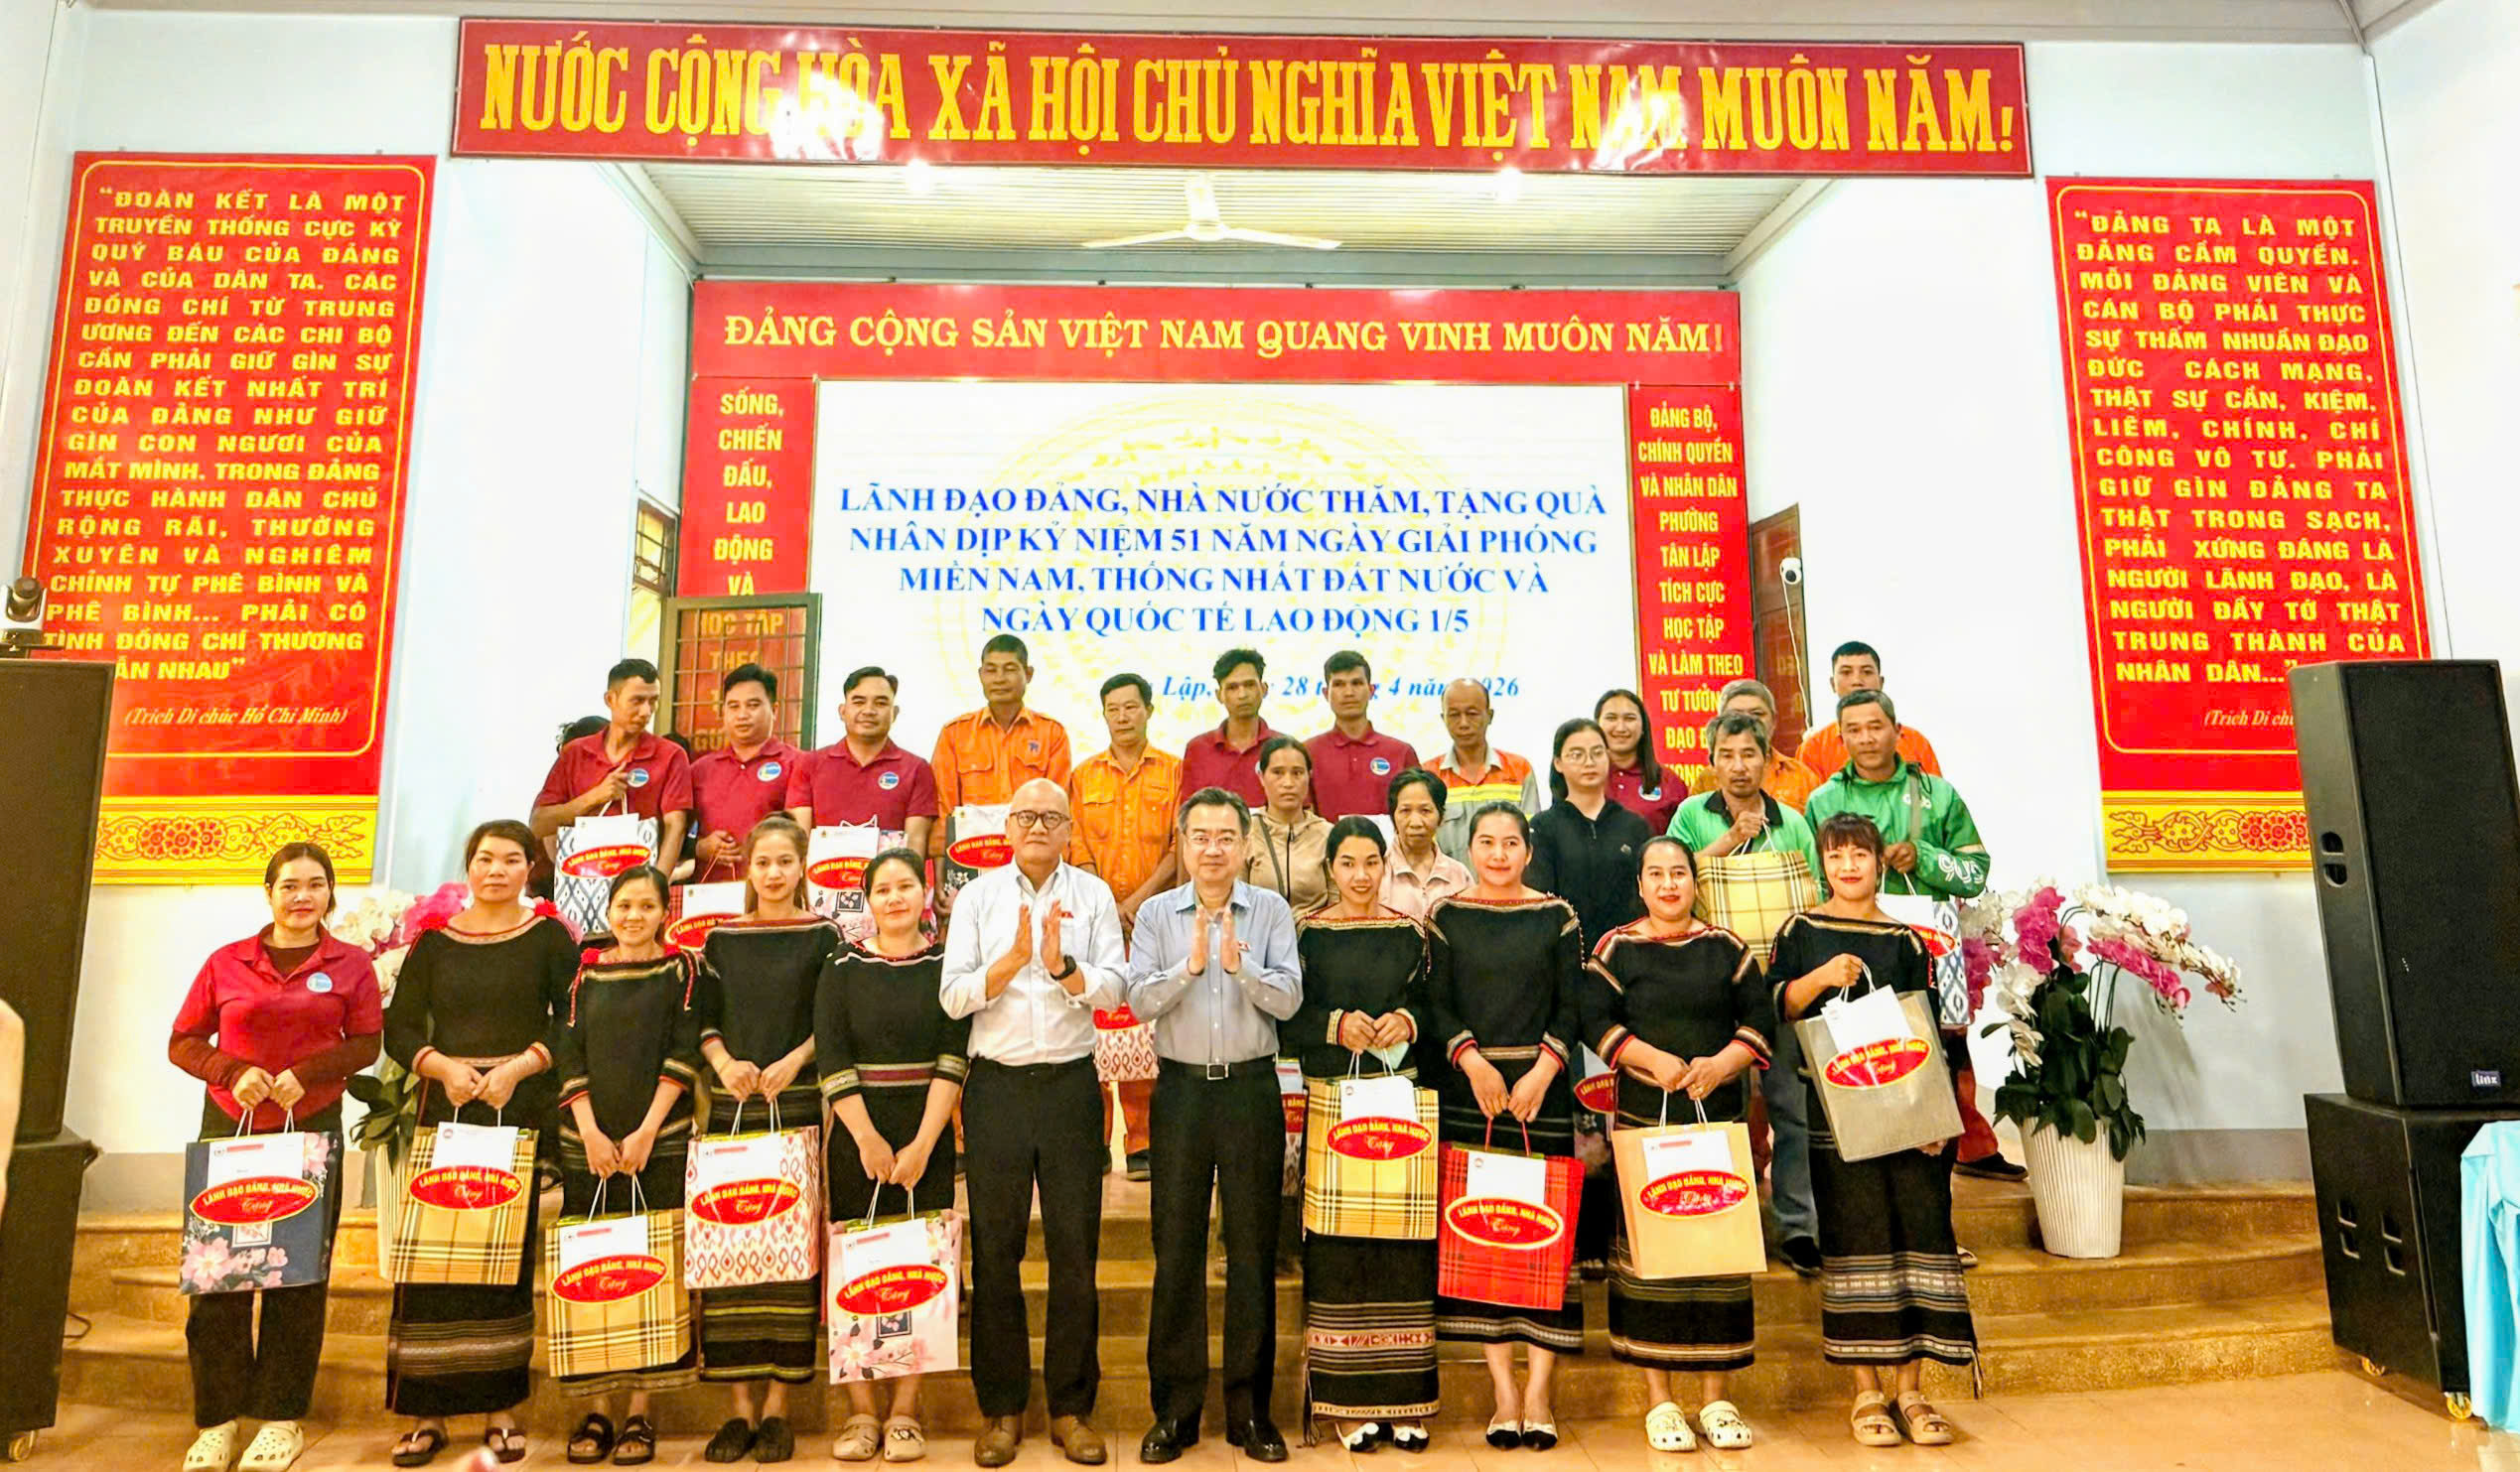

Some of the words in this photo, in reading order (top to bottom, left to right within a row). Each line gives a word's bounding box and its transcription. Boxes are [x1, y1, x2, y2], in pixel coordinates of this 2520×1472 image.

[480, 31, 630, 133] NƯỚC
[644, 33, 784, 148] CỘNG
[927, 41, 1018, 142] XÃ
[1029, 43, 1119, 156] HỘI
[1133, 46, 1238, 144] CHỦ
[1249, 48, 1420, 146] NGHĨA
[1421, 49, 1557, 162] VIỆT
[1568, 65, 1688, 151] NAM
[1698, 54, 1850, 151] MUÔN
[1864, 54, 2014, 152] NĂM!
[724, 306, 837, 346] ĐẢNG
[850, 308, 960, 356] CỘNG
[971, 308, 1049, 348] SẢN
[1057, 311, 1149, 359] VIỆT
[1160, 319, 1245, 349] NAM
[1257, 321, 1388, 358] QUANG
[1398, 322, 1491, 351] VINH
[1502, 315, 1614, 351] MUÔN
[720, 386, 784, 417] SỐNG,
[1650, 401, 1690, 428] ĐẢNG
[1693, 405, 1717, 433] BỘ,
[718, 423, 782, 452] CHIẾN
[1638, 438, 1682, 462] CHÍNH
[1686, 437, 1733, 465] QUYỀN
[723, 458, 772, 489] ĐẤU,
[1640, 472, 1660, 496] VÀ
[1663, 472, 1704, 496] NHÂN
[1708, 473, 1738, 496] DÂN
[726, 501, 766, 524] LAO
[840, 482, 935, 511] LÃNH
[944, 488, 1018, 518] ĐẠO
[1024, 481, 1129, 516] ĐẢNG,
[1136, 481, 1207, 512] NHÀ
[1215, 483, 1314, 514] NƯỚC
[1320, 484, 1430, 516] THĂM,
[1435, 487, 1527, 520] TẶNG
[1535, 484, 1607, 519] QUÀ
[714, 534, 773, 565] ĐỘNG
[850, 520, 946, 551] NHÂN
[955, 528, 1012, 558] DỊP
[1019, 520, 1066, 551] KỶ
[1075, 523, 1163, 558] NIỆM
[1171, 528, 1199, 552] 51
[1211, 522, 1288, 552] NĂM
[1296, 521, 1390, 553] NGÀY
[1397, 522, 1471, 553] GIẢI
[1479, 522, 1598, 554] PHÓNG
[1660, 543, 1689, 567] TÂN
[1693, 543, 1720, 571] LẬP
[728, 572, 756, 596] VÀ
[899, 560, 990, 592] MIỀN
[997, 567, 1085, 594] NAM,
[1092, 560, 1213, 592] THỐNG
[1221, 561, 1316, 593] NHẤT
[1323, 561, 1391, 593] ĐẤT
[1399, 562, 1495, 593] NƯỚC
[1502, 562, 1549, 593] VÀ
[1659, 578, 1692, 602] TÍCH
[1696, 581, 1725, 606] CỰC
[982, 600, 1079, 632] NGÀY
[1085, 601, 1185, 636] QUỐC
[1192, 600, 1234, 632] TẾ
[1245, 607, 1314, 632] LAO
[1323, 604, 1420, 638] ĐỘNG
[1431, 607, 1469, 633] 1/5
[1663, 617, 1693, 643] HỌC
[1697, 613, 1724, 643] TẬP
[1648, 649, 1668, 675] VÀ
[1671, 650, 1703, 675] LÀM
[1707, 654, 1743, 675] THEO
[1282, 675, 1309, 696] 28
[1388, 676, 1401, 697] 4
[1665, 727, 1696, 753] ĐẠO
